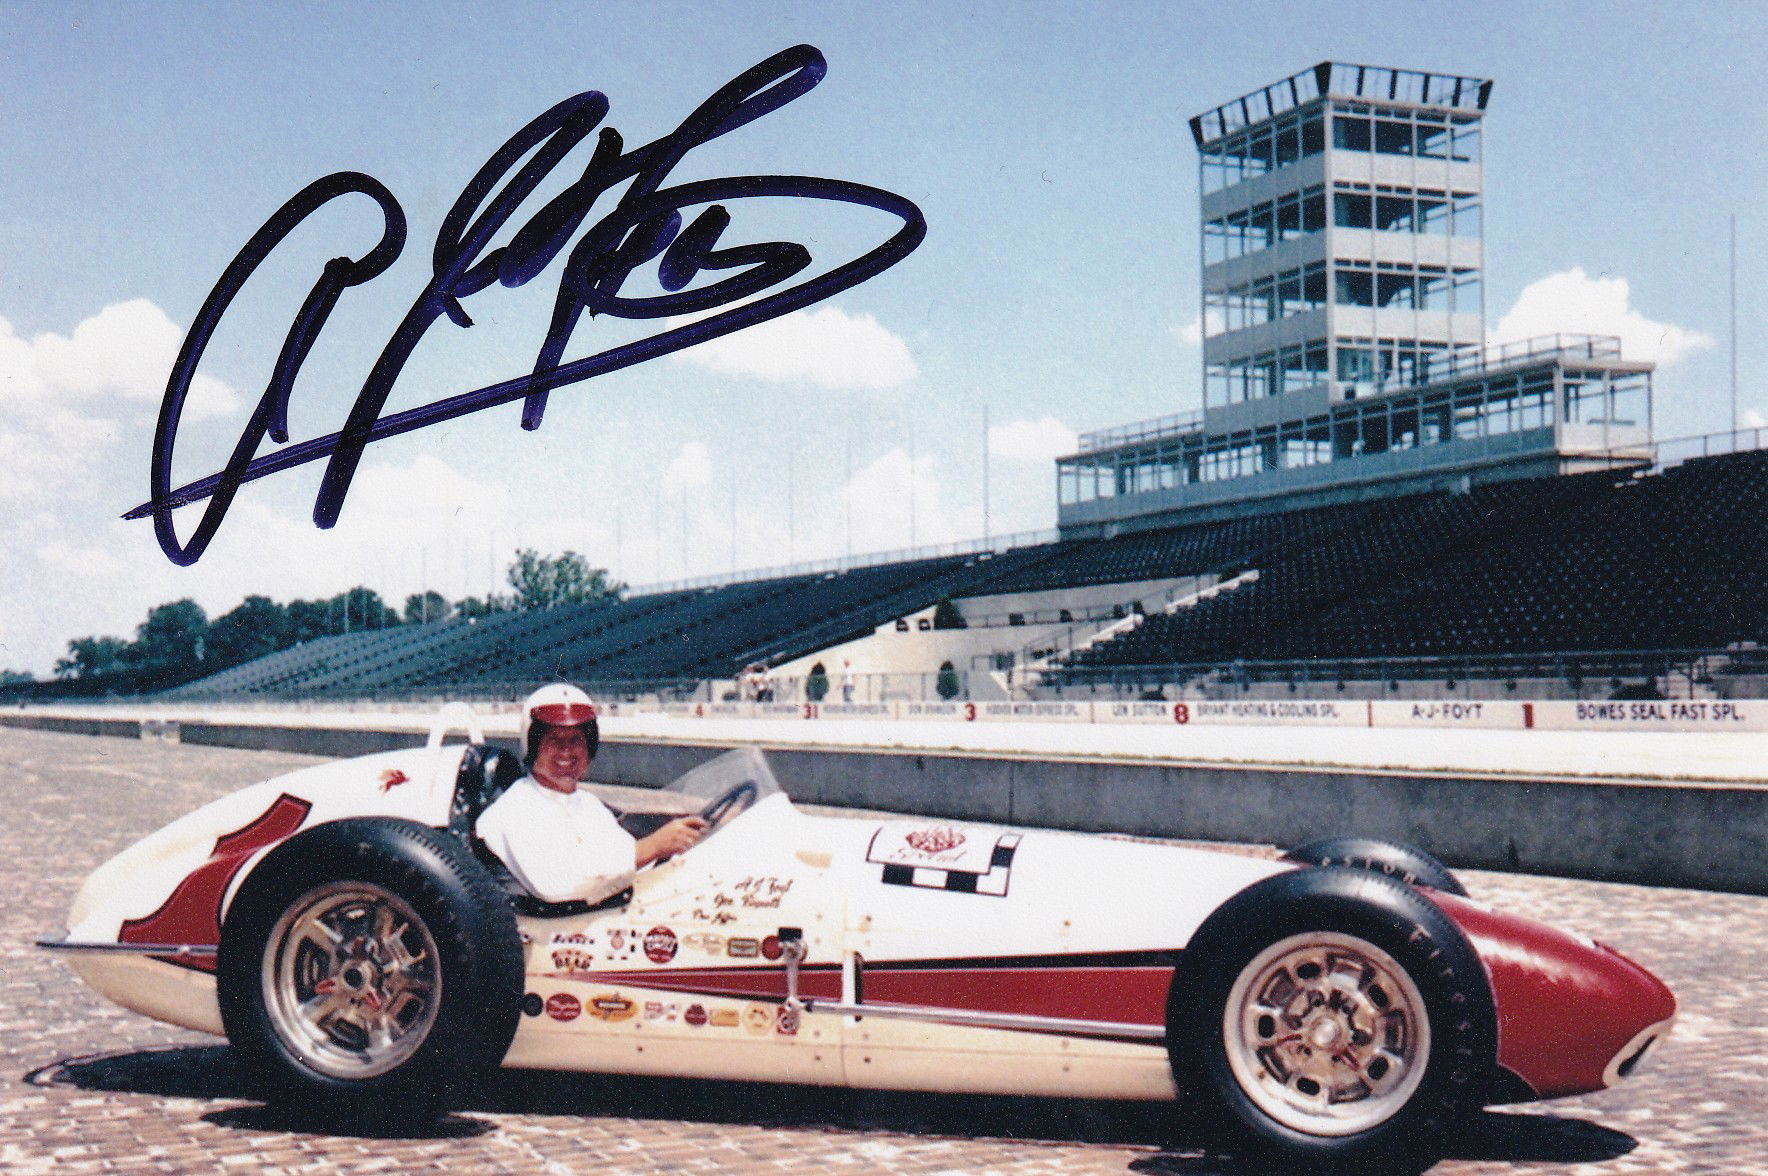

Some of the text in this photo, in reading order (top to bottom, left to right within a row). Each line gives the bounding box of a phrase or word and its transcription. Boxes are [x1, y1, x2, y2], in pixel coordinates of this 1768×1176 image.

[964, 703, 976, 721] 3
[1174, 704, 1189, 724] 8
[1521, 703, 1534, 728] 1
[1577, 703, 1746, 721] BOWES SEAL FAST SPL.
